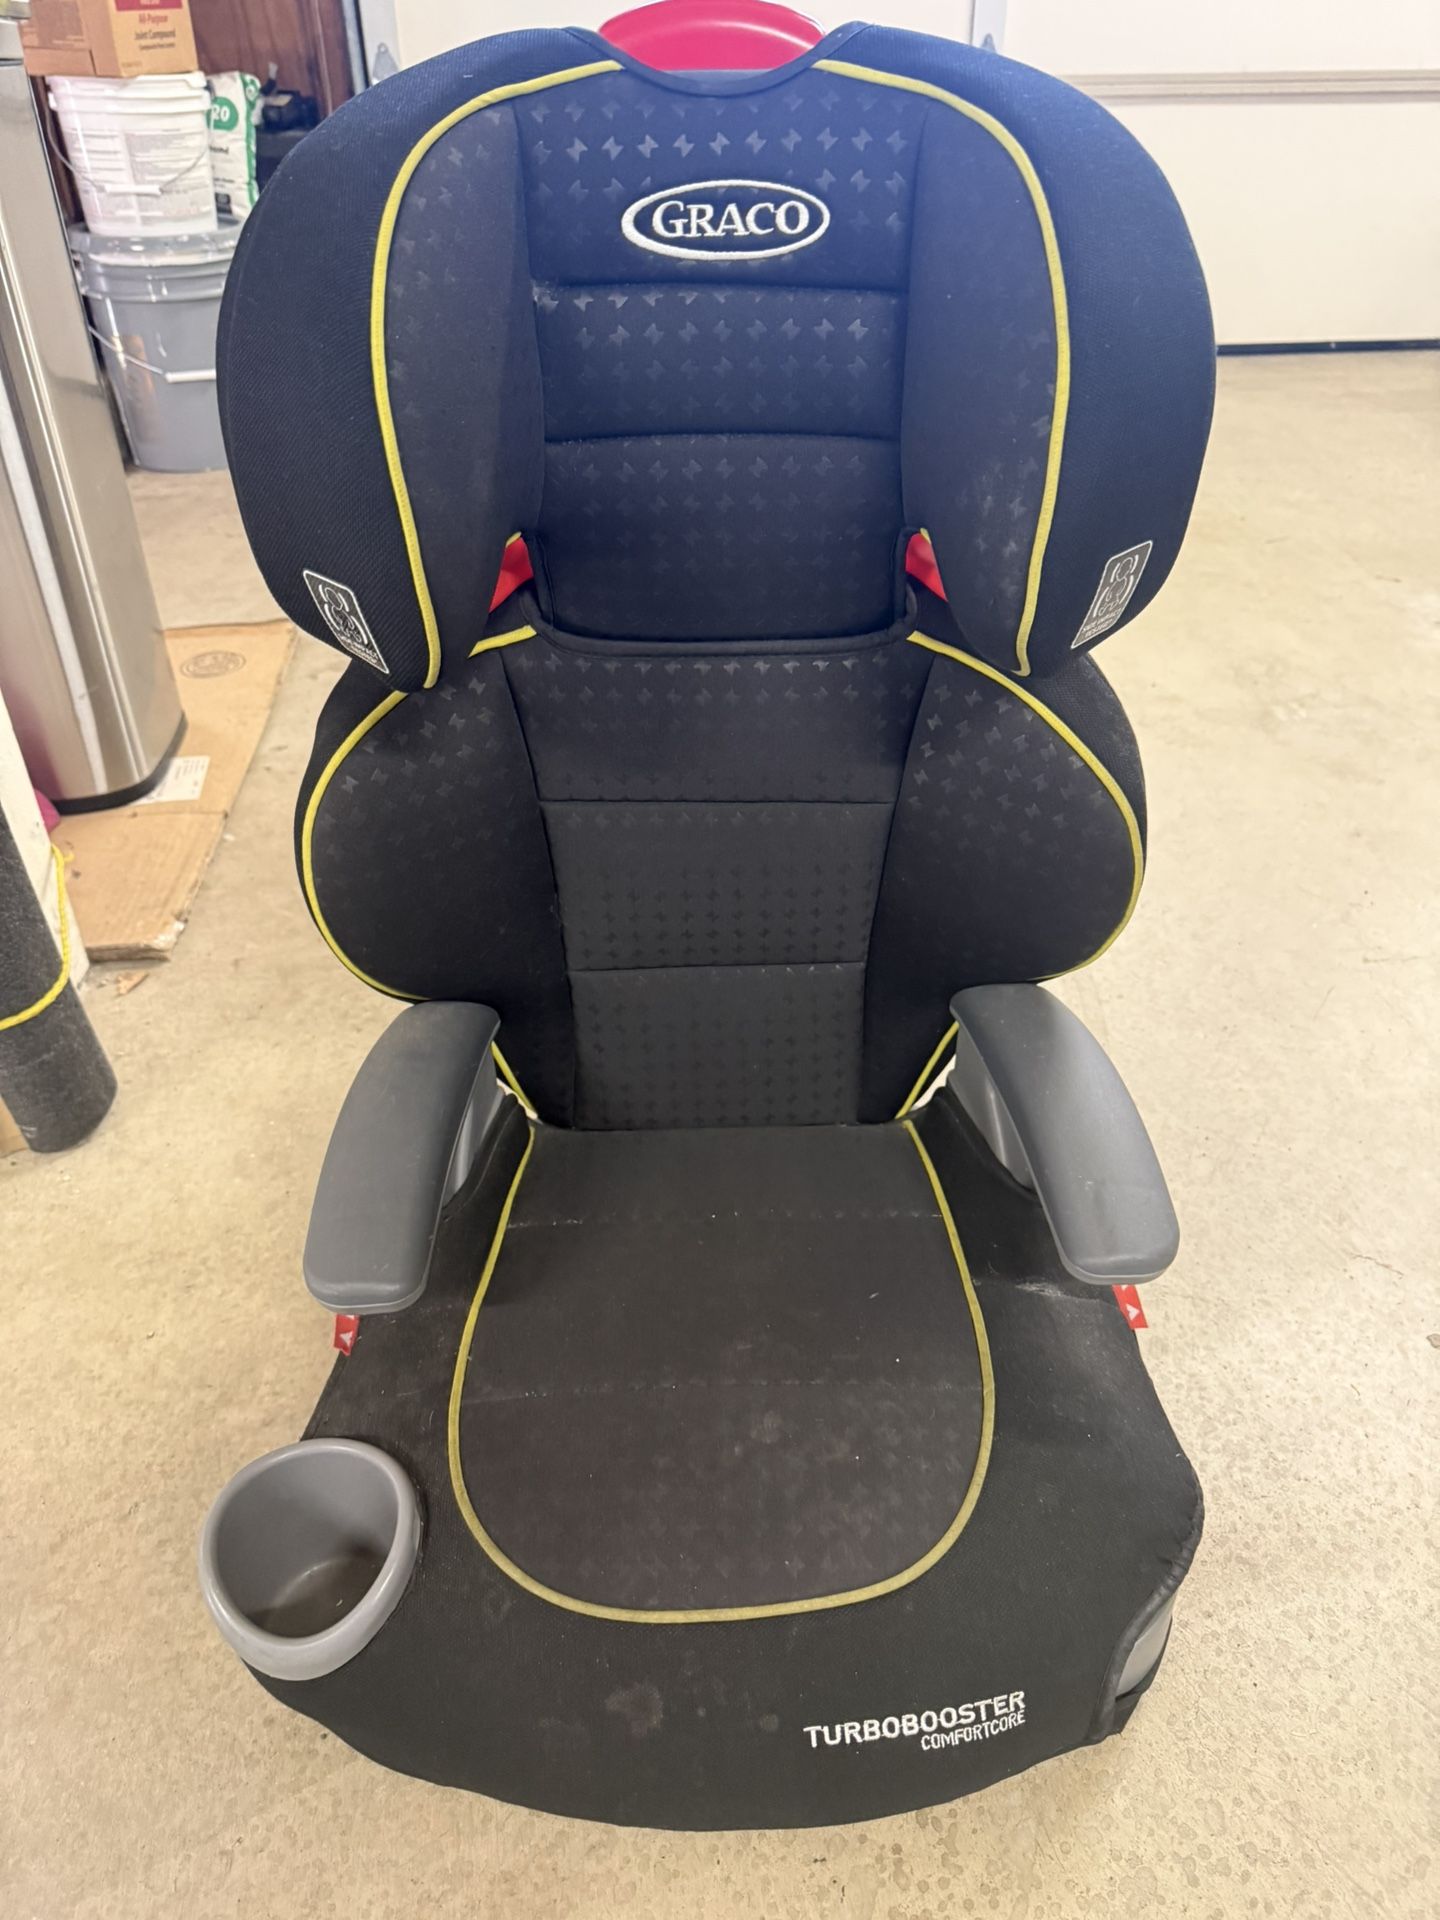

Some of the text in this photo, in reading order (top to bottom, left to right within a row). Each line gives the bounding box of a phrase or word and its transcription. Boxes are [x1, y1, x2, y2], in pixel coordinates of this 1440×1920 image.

[652, 200, 809, 238] GRACO
[803, 1691, 1026, 1748] TURBOBOOSTER
[920, 1710, 1026, 1751] COMFORTCORE
